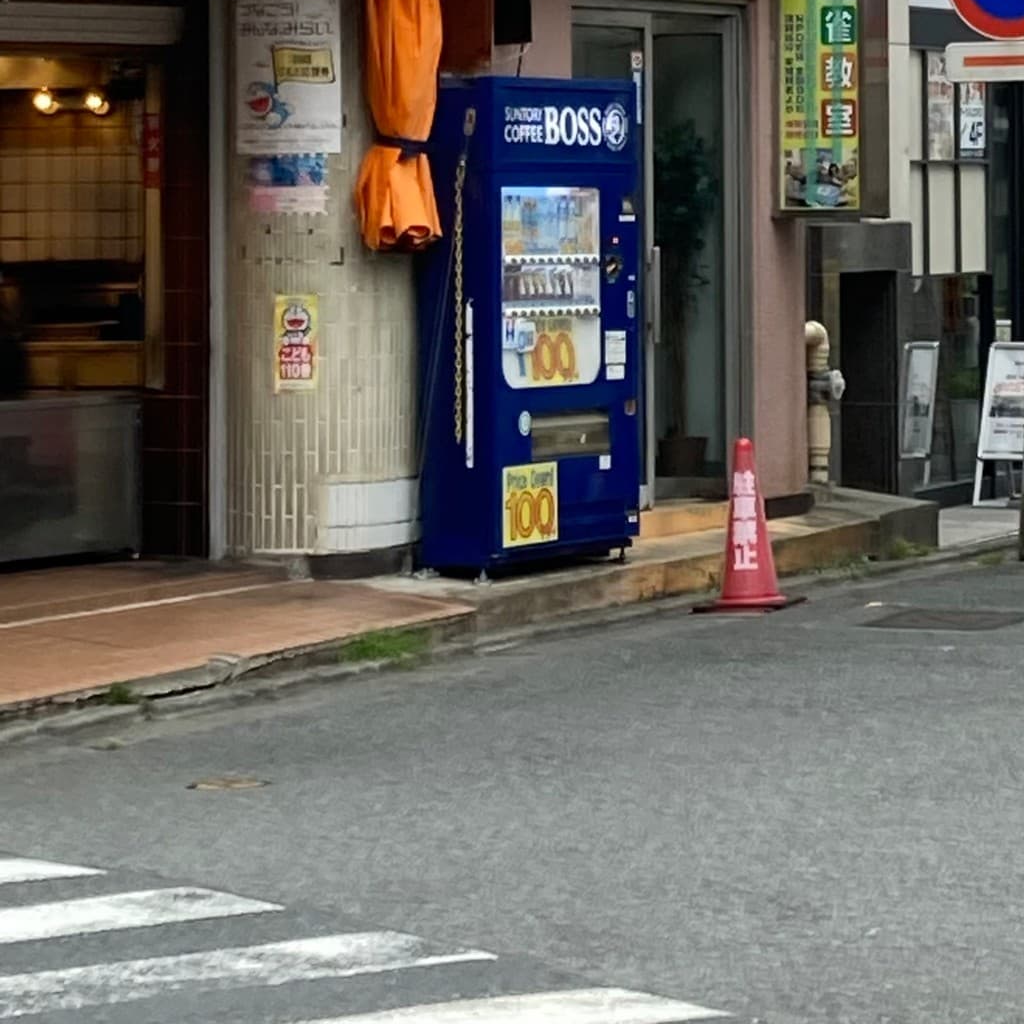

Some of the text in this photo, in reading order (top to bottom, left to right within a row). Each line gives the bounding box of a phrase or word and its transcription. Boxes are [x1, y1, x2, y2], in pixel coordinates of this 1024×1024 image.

[504, 106, 543, 122] SUNTORY
[504, 124, 543, 143] COFFEE
[544, 106, 601, 146] BOSS
